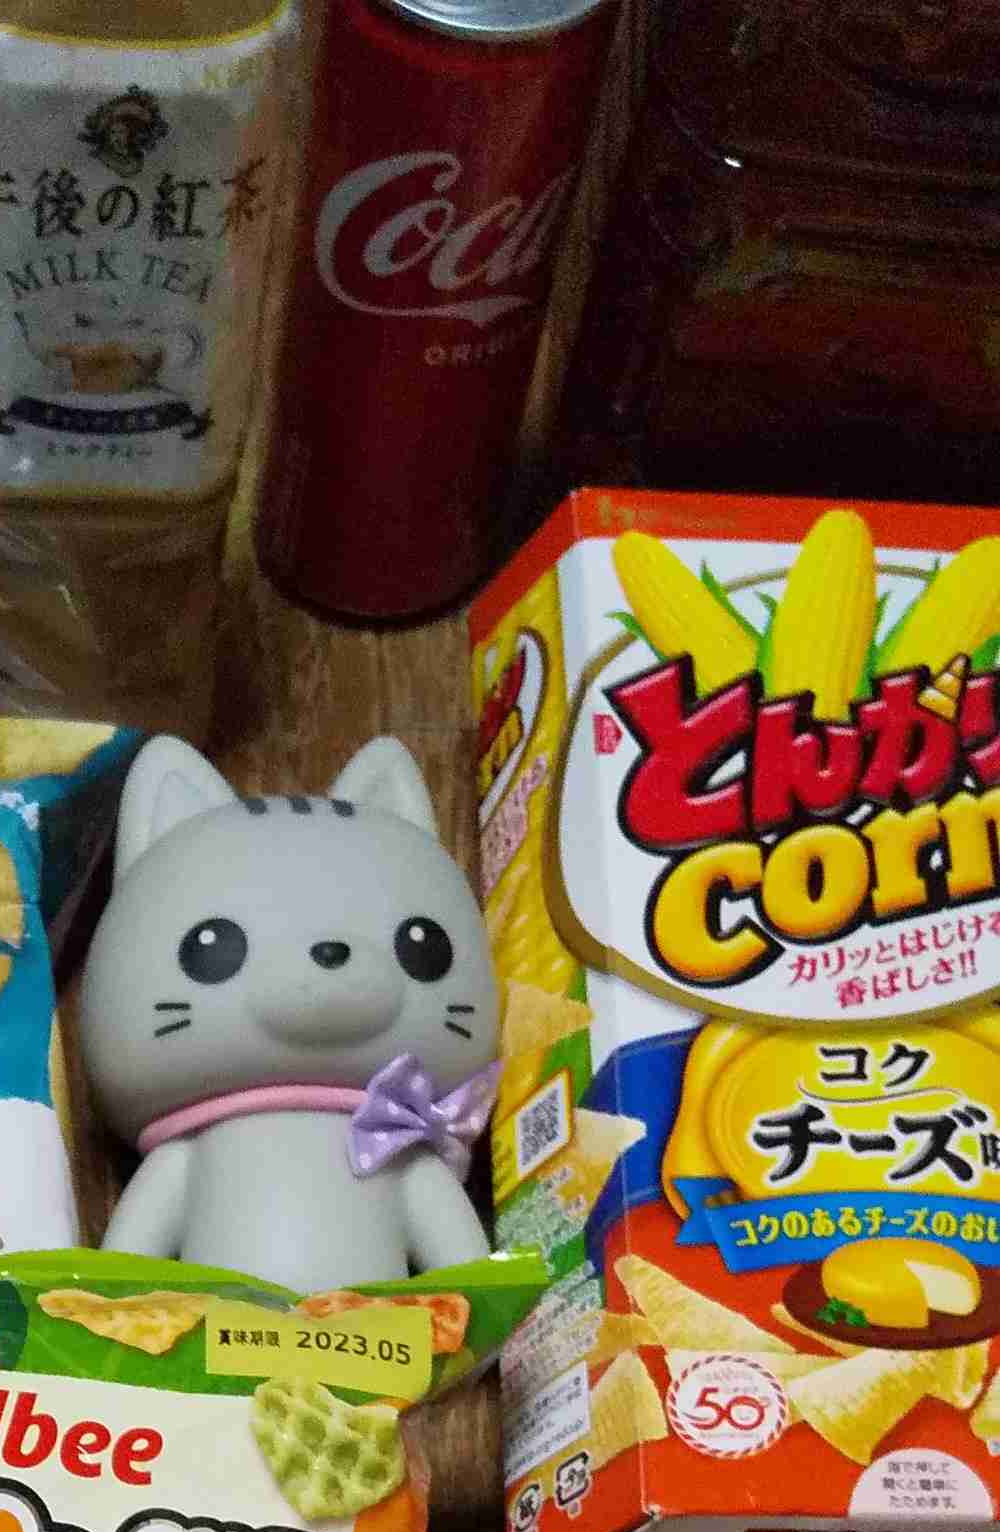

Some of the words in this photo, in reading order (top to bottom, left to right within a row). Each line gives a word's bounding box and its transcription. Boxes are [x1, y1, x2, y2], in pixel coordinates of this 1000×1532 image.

[5, 250, 123, 300] MILK
[818, 1043, 932, 1088] コク
[297, 1331, 411, 1366] 2023.05
